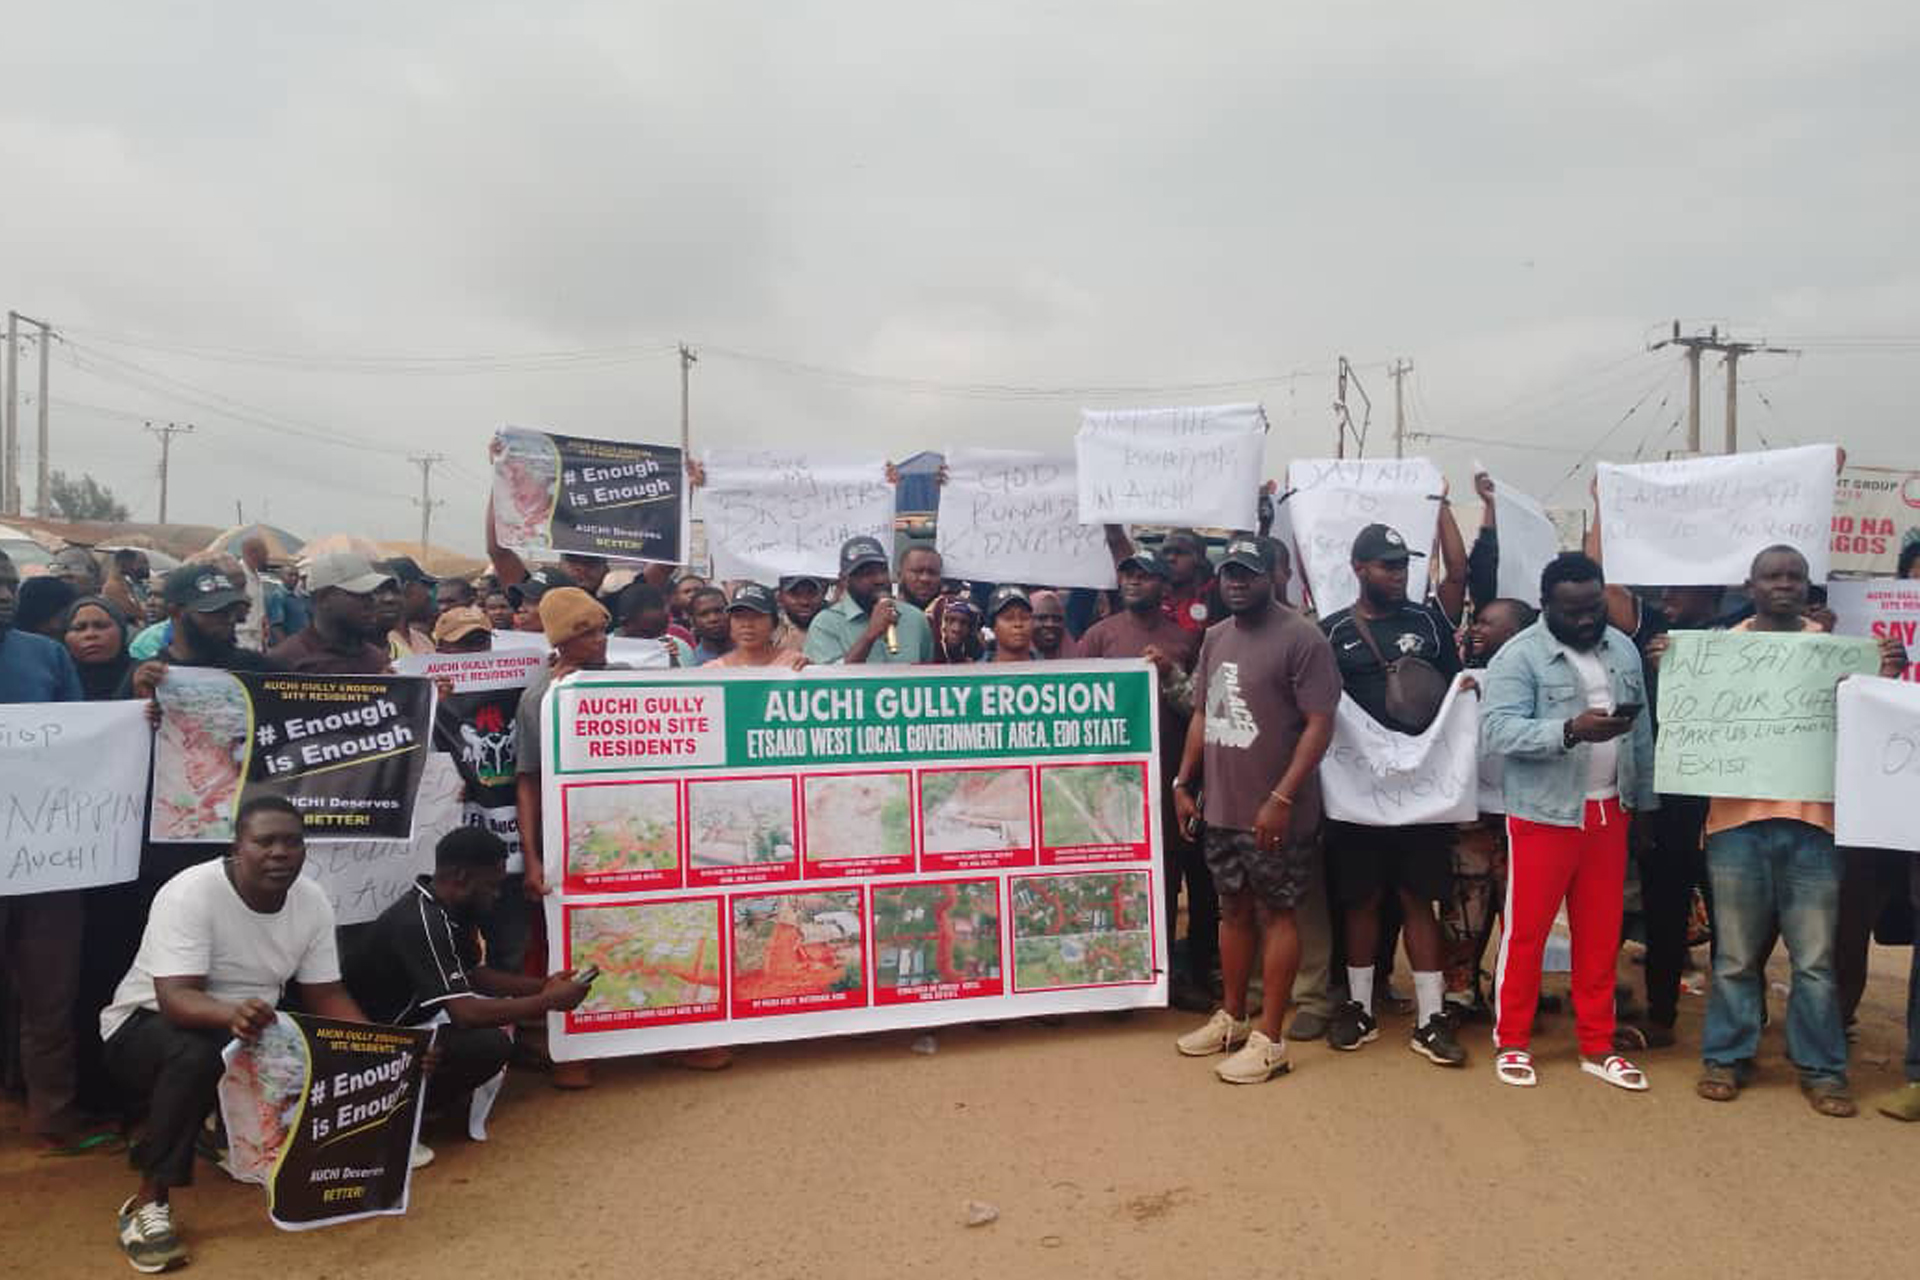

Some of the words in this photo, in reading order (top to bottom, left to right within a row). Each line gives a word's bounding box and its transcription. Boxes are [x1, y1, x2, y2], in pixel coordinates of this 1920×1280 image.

[582, 460, 659, 482] Enough
[569, 492, 588, 506] is
[593, 479, 670, 502] Enough
[1831, 535, 1886, 554] GOS
[1871, 620, 1918, 646] SAY
[1667, 640, 1723, 677] WE
[263, 681, 298, 691] AUCHI
[577, 697, 638, 715] AUCHI
[644, 696, 705, 713] GULLY
[763, 688, 864, 722] AUCHI
[875, 685, 971, 719] GULLY
[980, 682, 1116, 716] EROSION
[285, 700, 398, 740] Enough
[575, 719, 661, 736] EROSION
[668, 717, 709, 734] SITE
[265, 754, 294, 774] is
[302, 725, 413, 764] Enough
[588, 738, 697, 758] RESIDENTS
[747, 729, 806, 758] ETSAKO
[811, 727, 852, 756] WEST
[857, 725, 903, 755] LOCAL
[906, 722, 1003, 752] GOVERNMENT
[1053, 720, 1080, 747] EDO
[329, 797, 399, 808] Deserves
[333, 1051, 413, 1098] Enough
[313, 1117, 329, 1140] is
